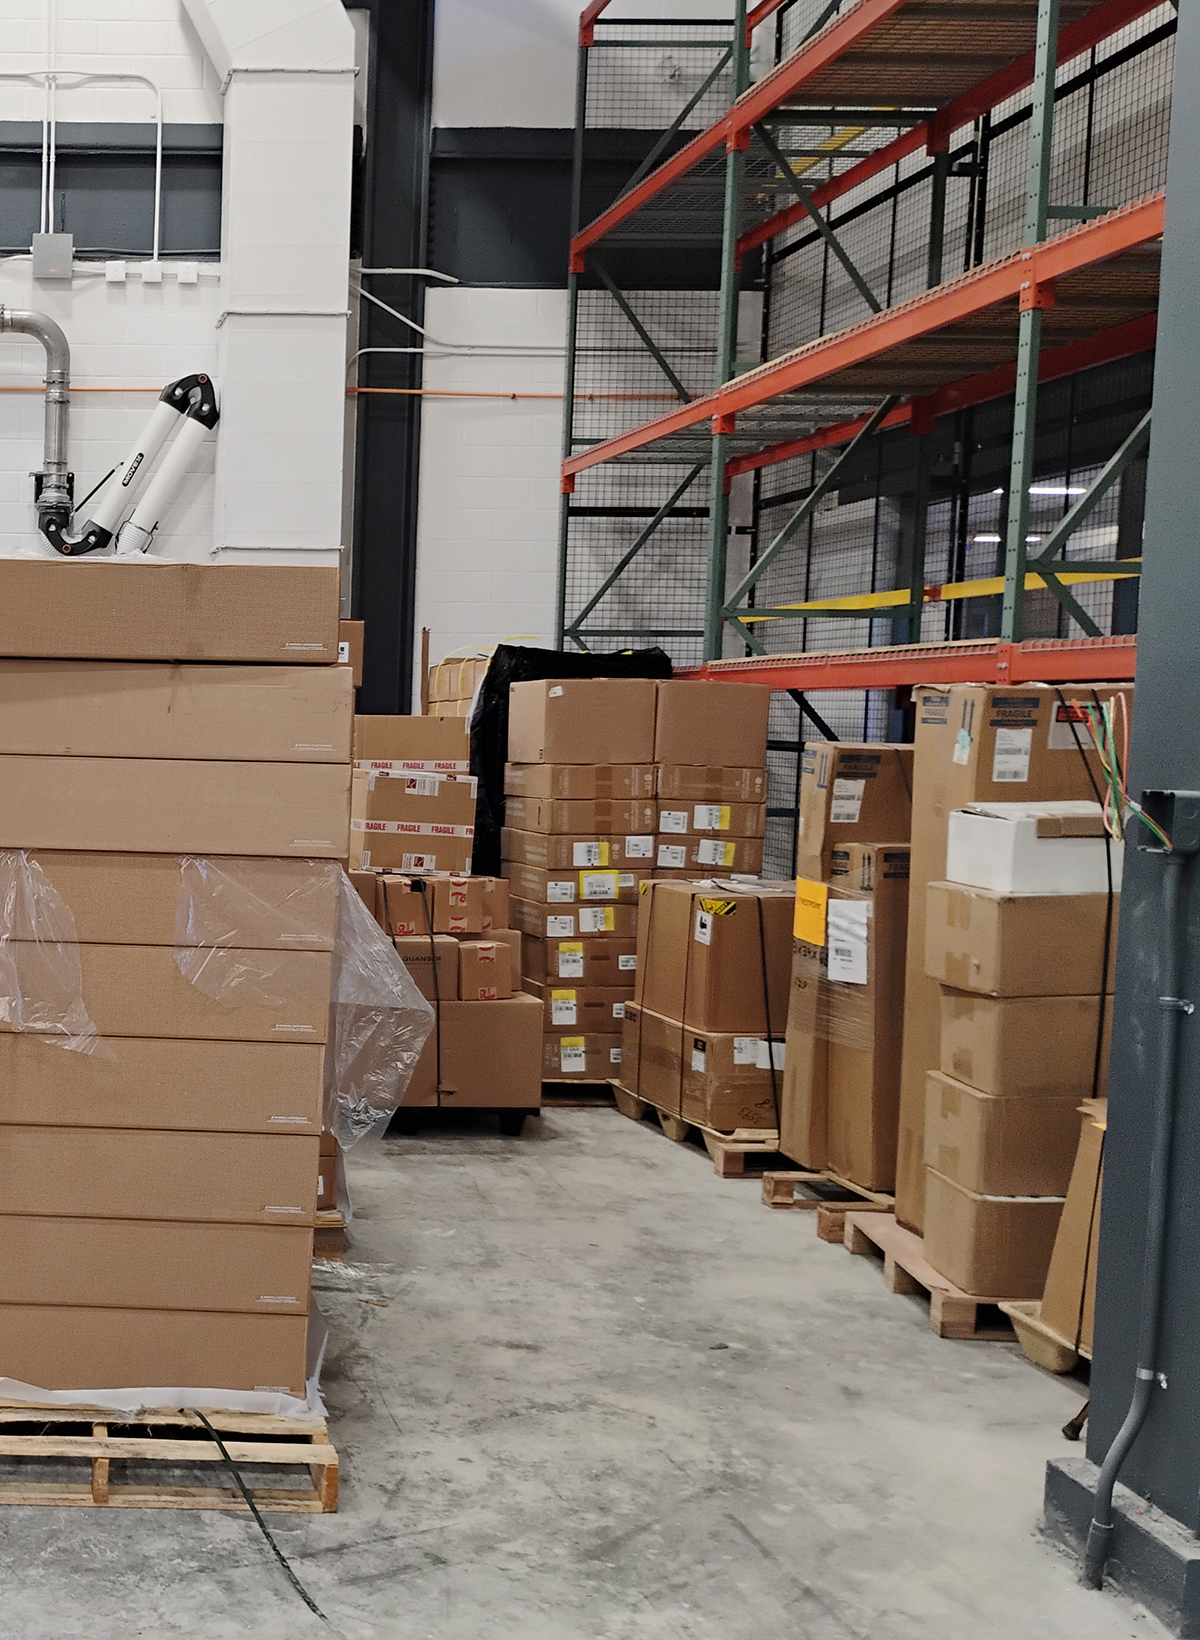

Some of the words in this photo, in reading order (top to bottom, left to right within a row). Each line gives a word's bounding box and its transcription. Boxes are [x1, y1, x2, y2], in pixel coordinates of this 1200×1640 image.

[123, 454, 143, 485] MOVEX
[996, 709, 1033, 718] FRAGILE
[371, 762, 393, 770] FRAGILE
[403, 762, 425, 770] FRAGILE
[434, 762, 457, 770] FRAGILE
[365, 822, 386, 831] RAGILE
[397, 824, 421, 832] FRAGILE
[431, 825, 455, 835] FRAGILE
